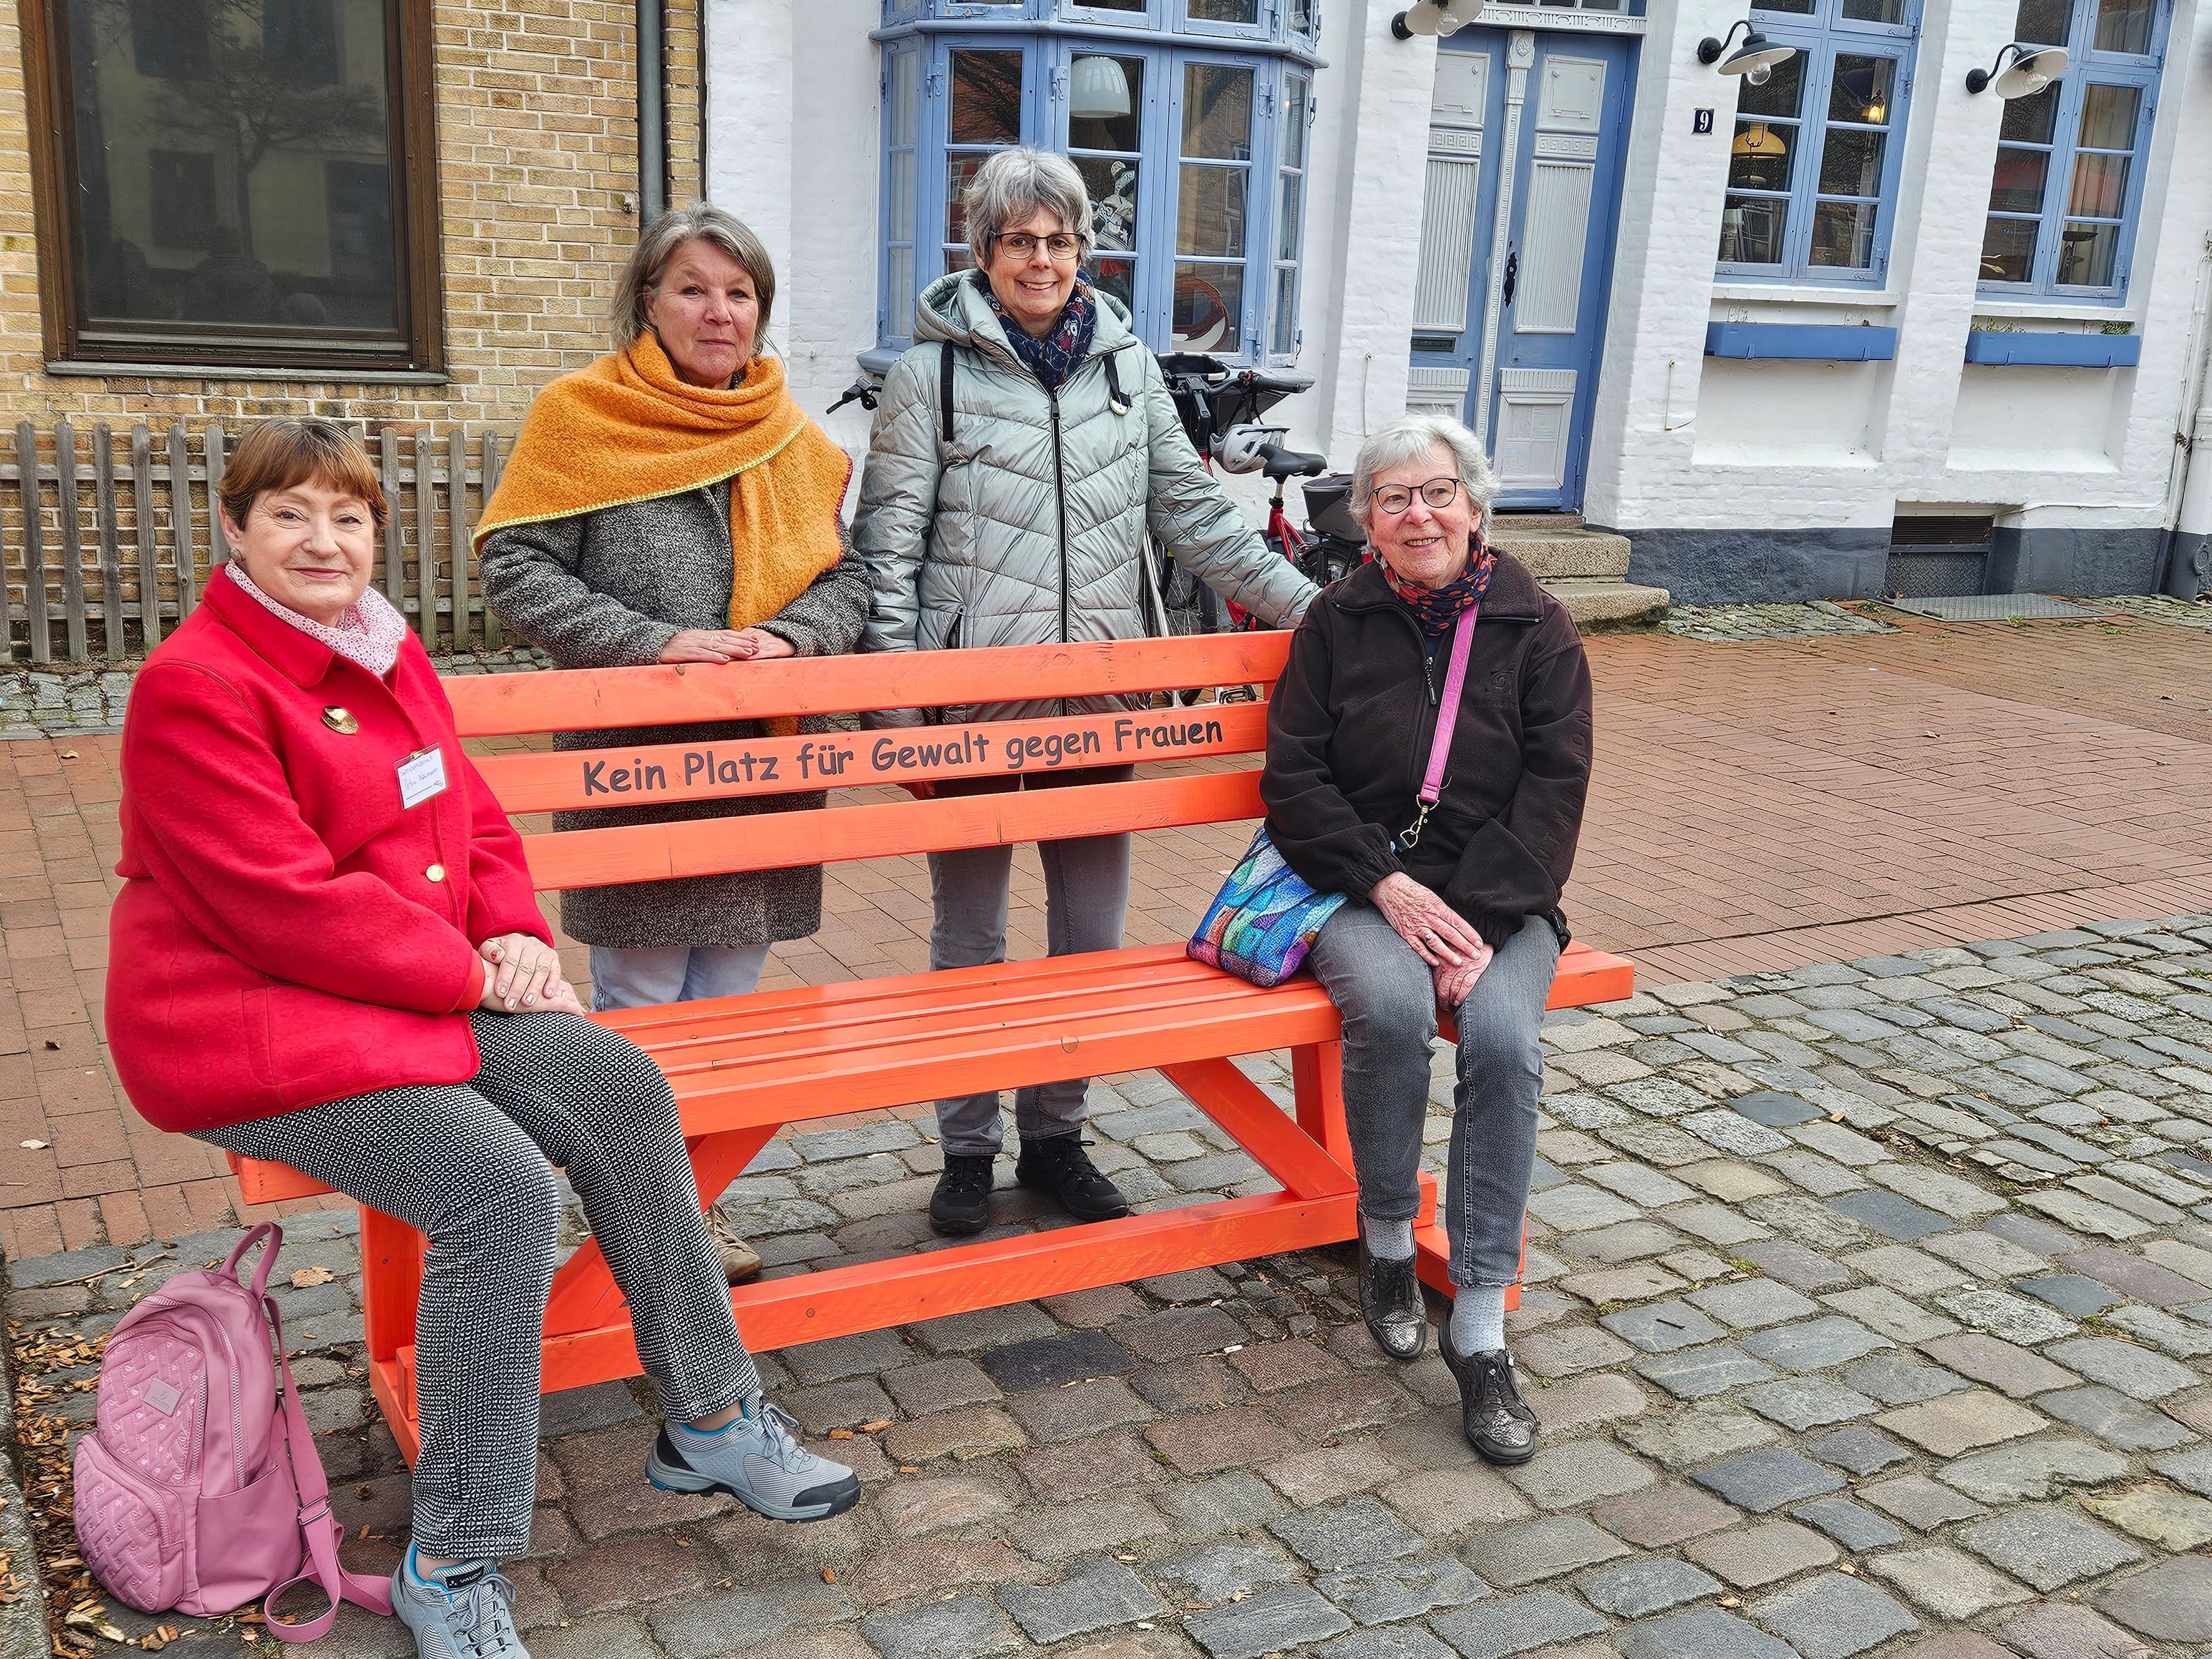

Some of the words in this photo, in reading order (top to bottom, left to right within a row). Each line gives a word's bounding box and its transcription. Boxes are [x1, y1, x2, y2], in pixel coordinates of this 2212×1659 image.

[1699, 111, 1709, 131] 9
[583, 757, 666, 797] Kein
[684, 751, 779, 786] Platz
[796, 743, 854, 779] für
[872, 730, 990, 771] Gewalt
[1006, 731, 1100, 770] gegen
[1115, 719, 1223, 752] Frauen
